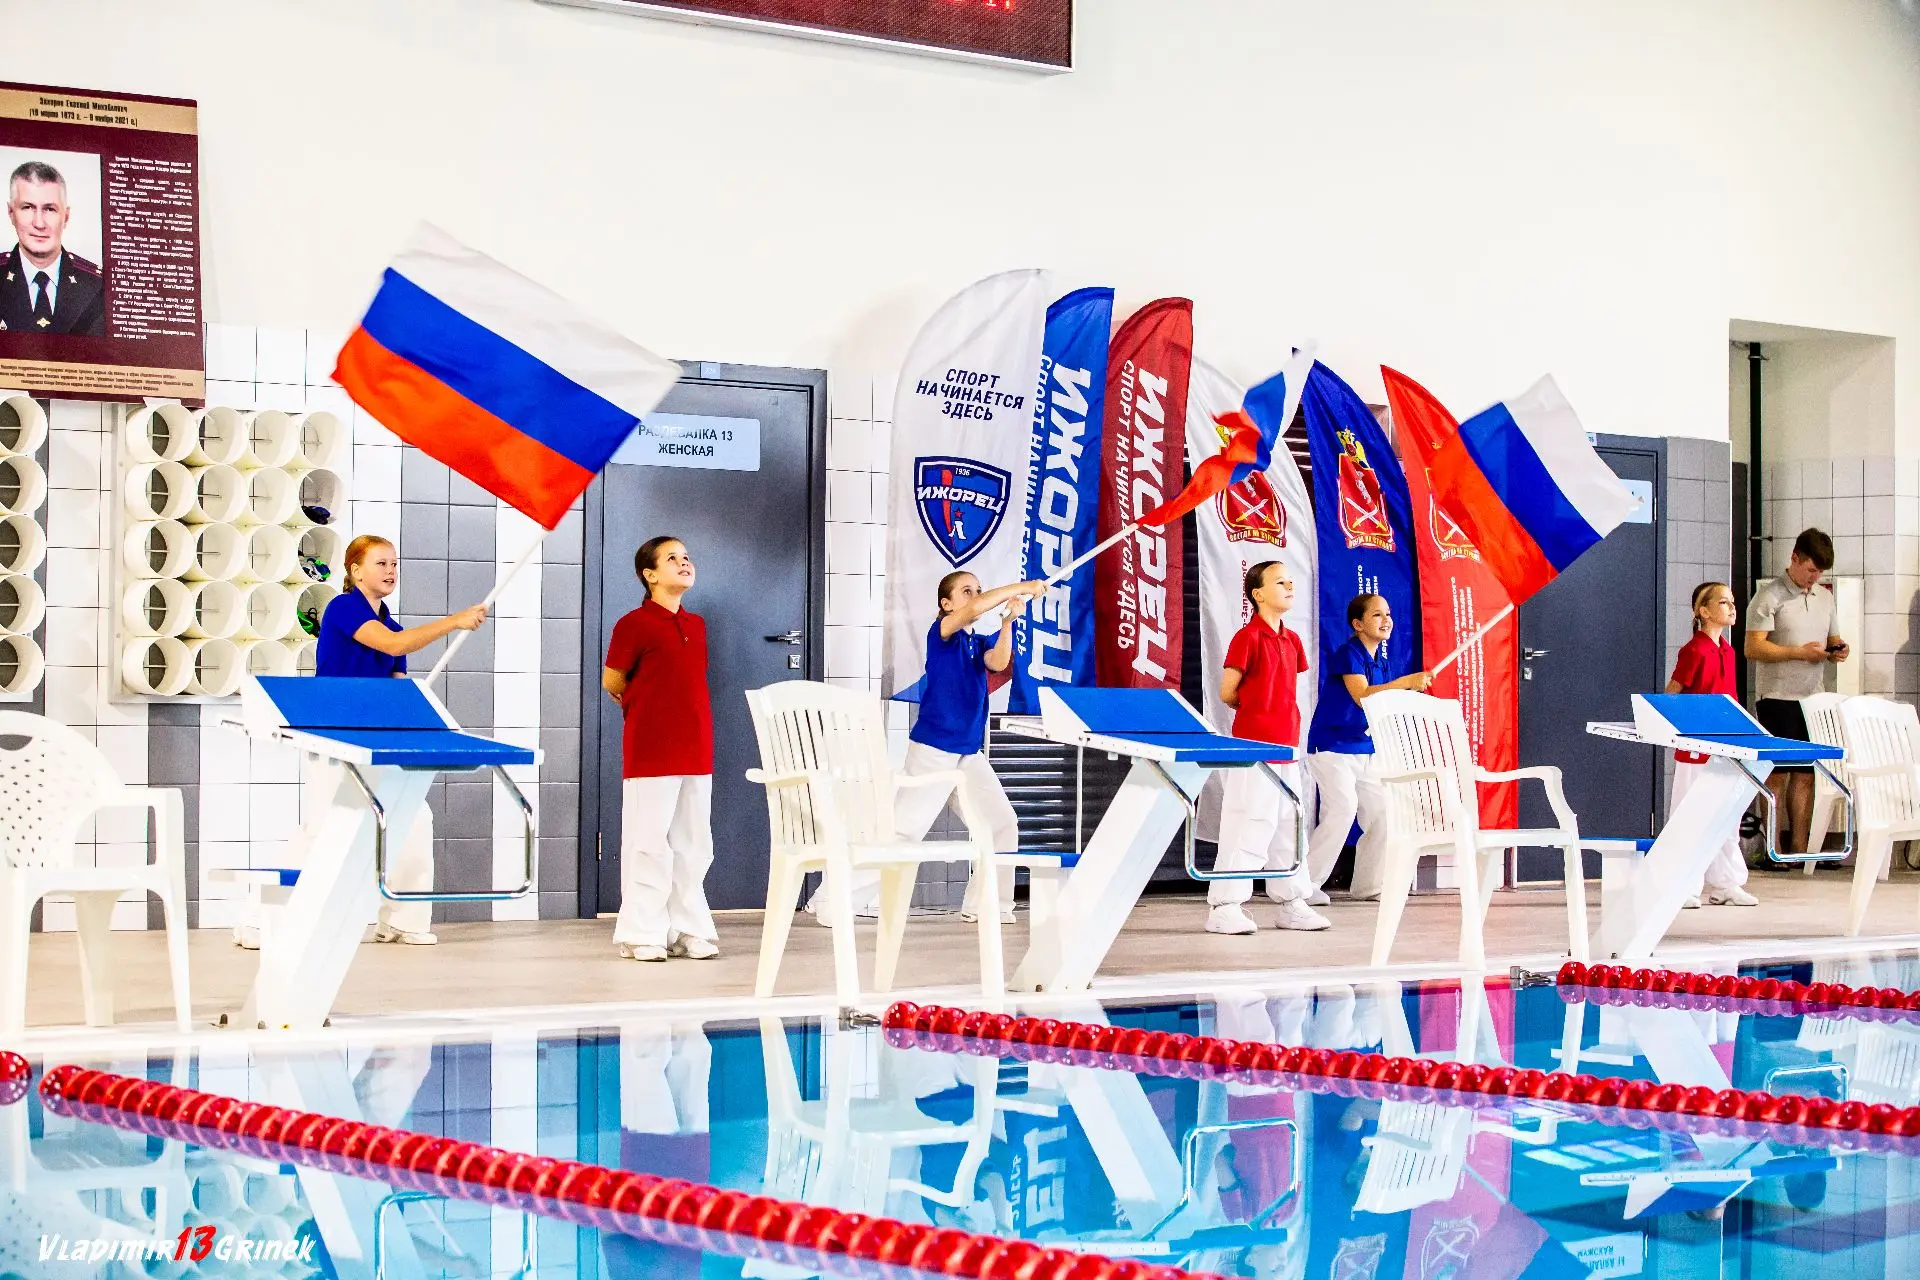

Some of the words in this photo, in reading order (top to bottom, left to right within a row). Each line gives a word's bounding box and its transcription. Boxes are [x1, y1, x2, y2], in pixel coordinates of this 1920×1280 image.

[945, 368, 1001, 389] СПОРТ
[916, 379, 1025, 410] НАЧИНАЕТСЯ
[1118, 359, 1135, 431] СПОРТ
[941, 400, 994, 421] ЗДЕСЬ
[721, 430, 733, 442] 13
[658, 443, 714, 457] ЖЕНСКАЯ
[955, 467, 971, 476] 1936
[916, 486, 1005, 514] ИЖОРЕЦ
[1028, 362, 1092, 684] ИЖОРЕЦ
[1116, 578, 1137, 650] ЗДЕСЬ
